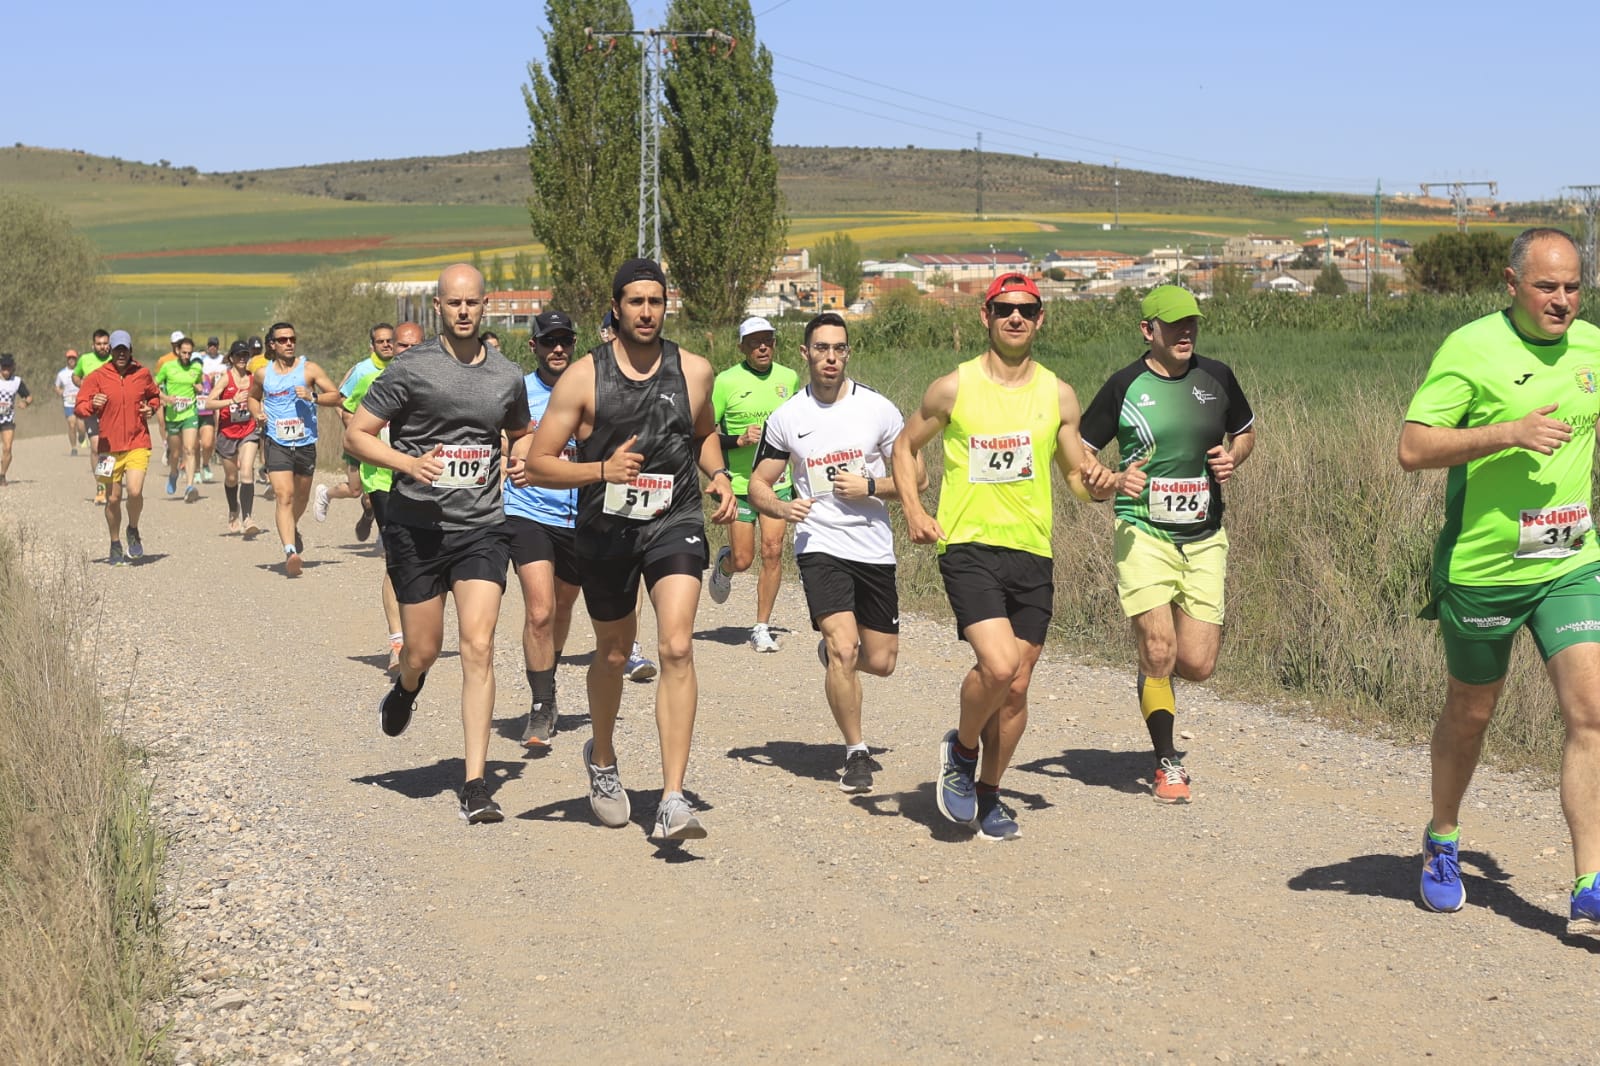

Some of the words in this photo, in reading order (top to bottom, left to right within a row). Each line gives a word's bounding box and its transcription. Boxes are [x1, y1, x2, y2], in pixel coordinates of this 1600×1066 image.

[284, 426, 296, 434] 71
[970, 435, 1031, 449] bedunia
[436, 448, 490, 459] bedunia
[806, 449, 863, 468] bedunia
[989, 451, 1014, 470] 49
[448, 461, 480, 477] 109
[1151, 481, 1209, 493] bedunia
[626, 489, 650, 507] 51
[1163, 495, 1198, 511] 126
[1522, 506, 1588, 527] bedunia
[1543, 526, 1571, 545] 31
